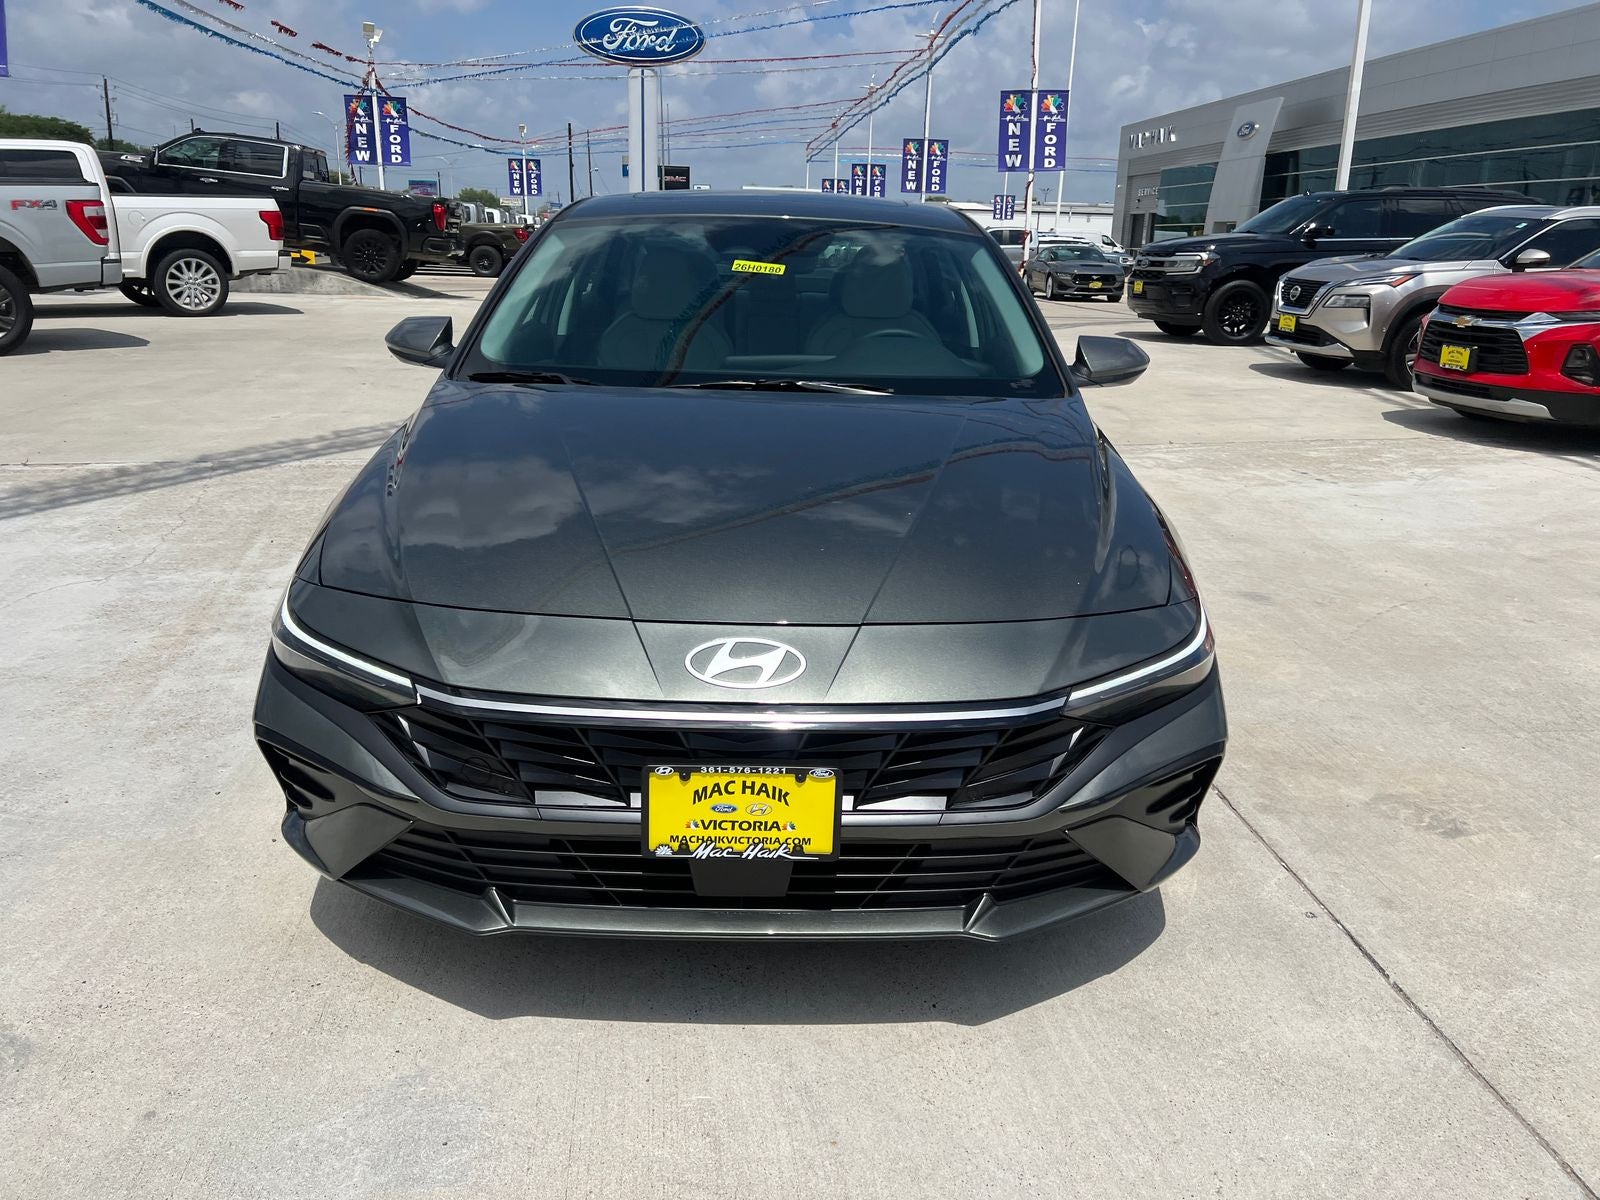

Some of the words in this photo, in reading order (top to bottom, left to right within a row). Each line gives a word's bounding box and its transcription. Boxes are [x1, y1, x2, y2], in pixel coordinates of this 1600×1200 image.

[602, 17, 678, 52] Ford
[355, 123, 371, 162] NEW
[389, 124, 403, 163] FORD
[1004, 122, 1022, 168] NEW
[1044, 122, 1058, 168] FORD
[512, 172, 521, 194] NEW
[530, 173, 538, 195] FORD
[905, 159, 917, 190] NEW
[931, 160, 941, 191] FORD
[1138, 187, 1159, 196] SERVICE
[11, 199, 58, 210] FX4
[734, 263, 782, 274] 26H0180
[700, 766, 787, 775] 361-576-1221
[693, 780, 736, 805] MAC
[741, 780, 790, 807] HAIK
[713, 804, 735, 813] Ford
[700, 819, 782, 832] VICTORIA
[669, 835, 812, 846] MACHAIKVICTORIA.COM
[692, 842, 741, 860] Mac
[742, 842, 799, 860] Haik
